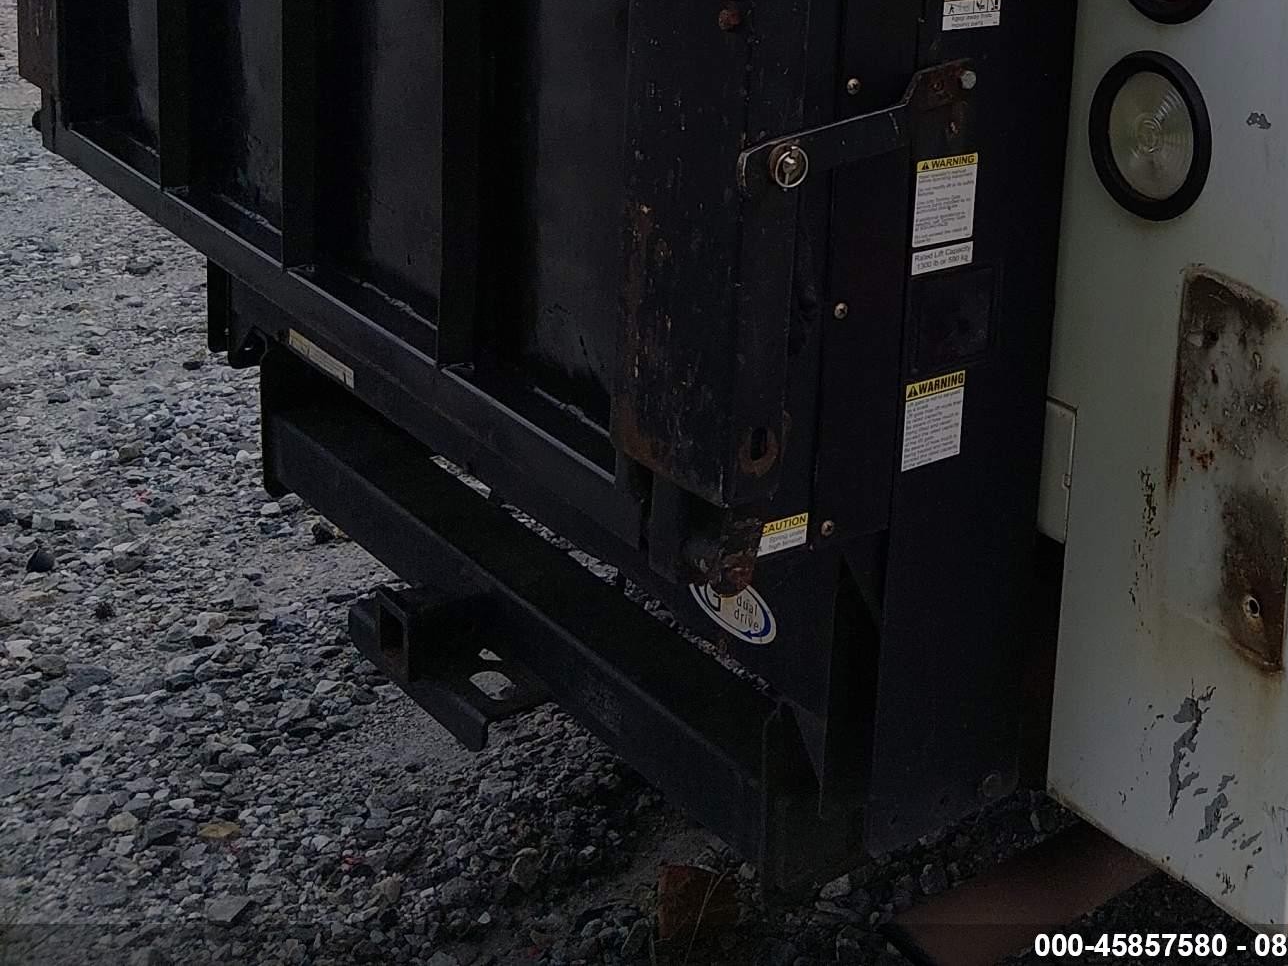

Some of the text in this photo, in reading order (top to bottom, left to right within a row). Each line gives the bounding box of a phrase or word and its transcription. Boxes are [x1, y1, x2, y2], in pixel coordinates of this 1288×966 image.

[931, 155, 976, 169] WARNING
[918, 373, 965, 394] WARNING
[736, 596, 758, 618] dual
[734, 609, 760, 632] drive
